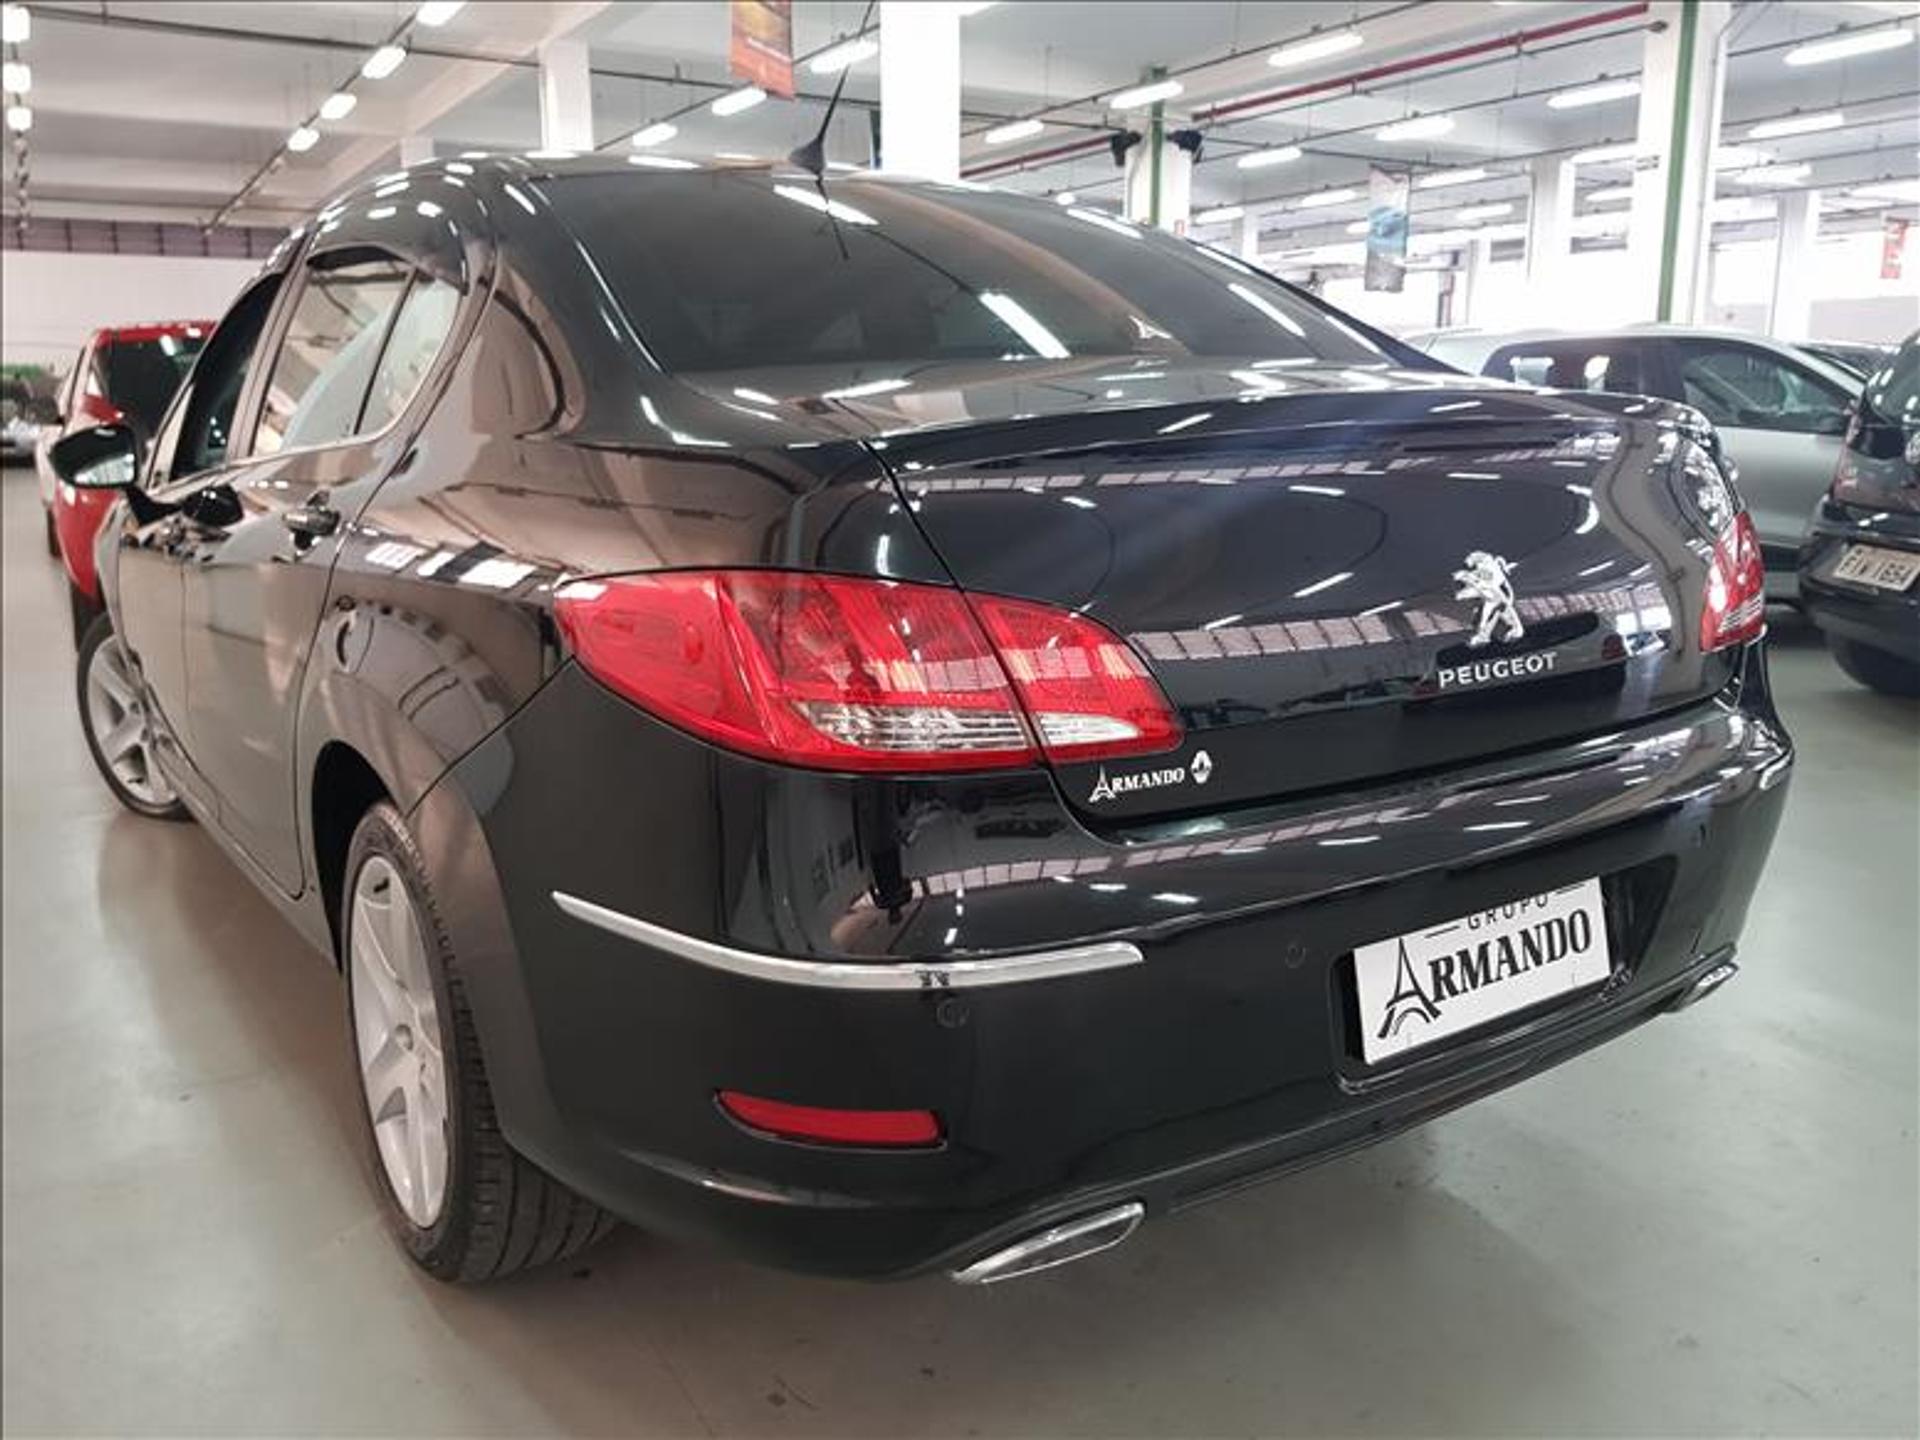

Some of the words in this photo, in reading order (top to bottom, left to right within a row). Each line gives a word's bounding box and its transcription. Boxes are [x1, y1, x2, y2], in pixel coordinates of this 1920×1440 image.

[1438, 652, 1557, 689] PEUGEOT
[1467, 895, 1549, 930] GRUPO
[1377, 908, 1592, 1039] ARMANDO
